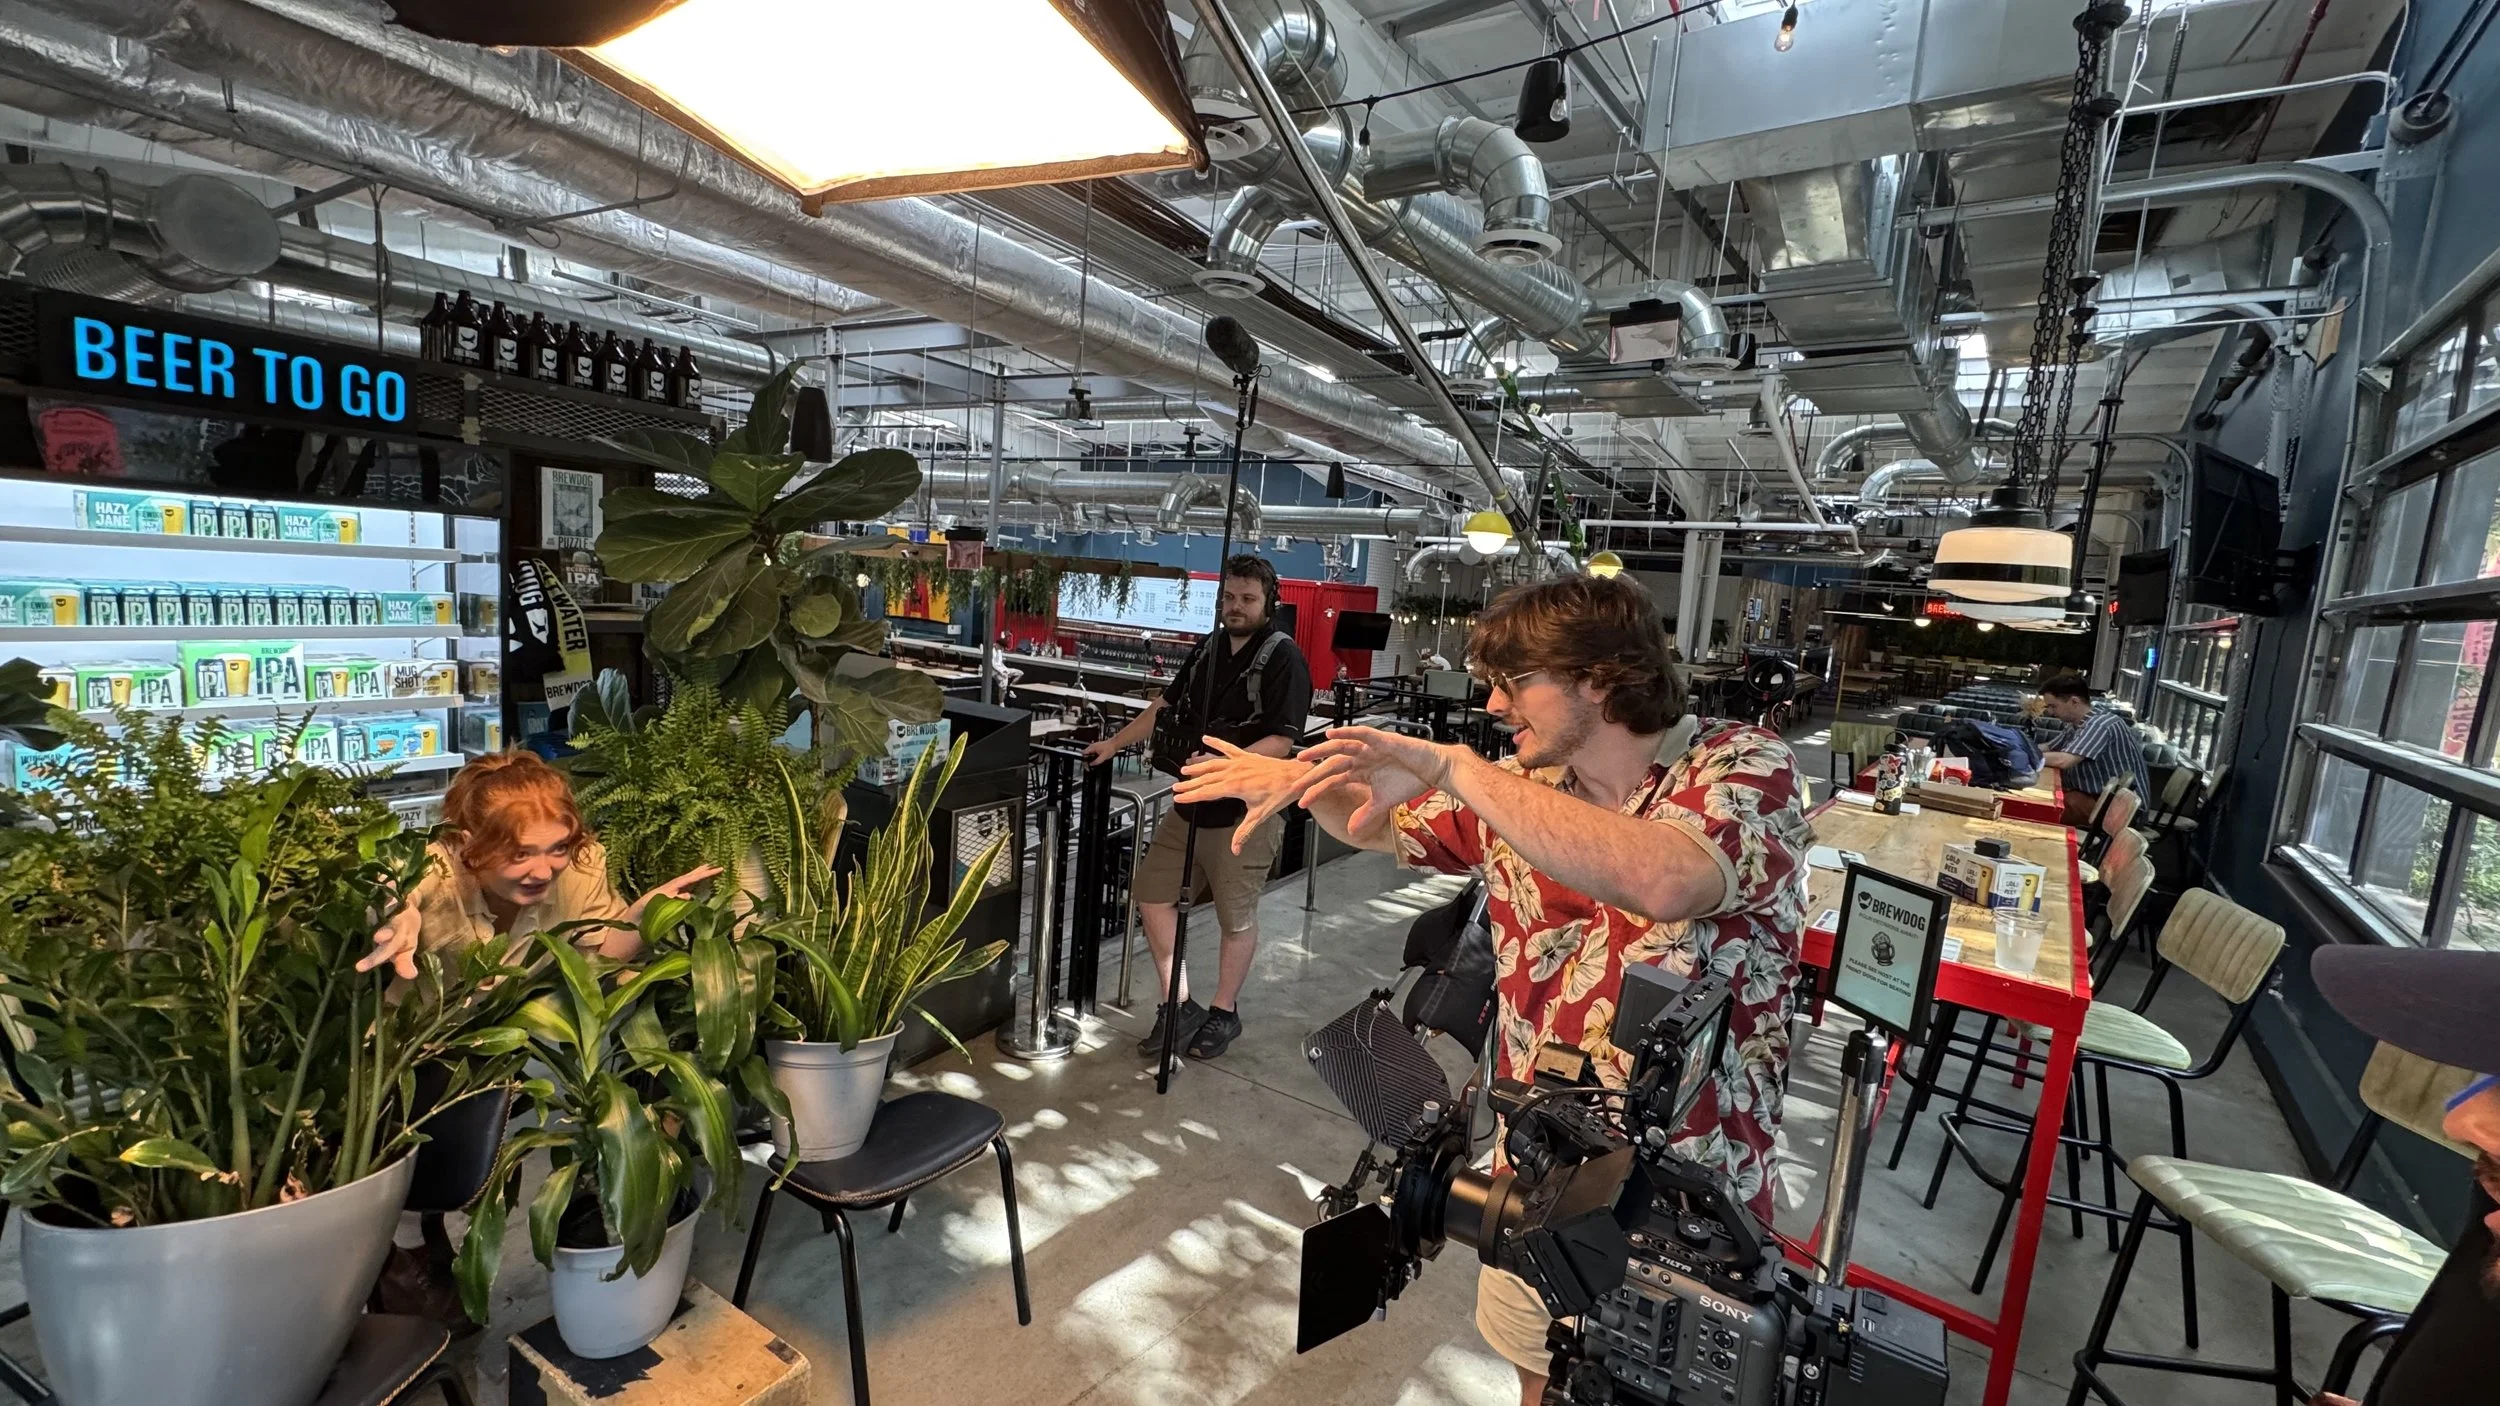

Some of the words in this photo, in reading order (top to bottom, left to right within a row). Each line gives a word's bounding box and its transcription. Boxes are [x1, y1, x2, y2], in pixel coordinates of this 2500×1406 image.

[73, 316, 236, 400] BEER
[252, 347, 323, 411] TO
[341, 363, 406, 422] GO
[552, 470, 593, 487] BREWDOG
[95, 501, 130, 515] HAZY
[95, 514, 132, 527] JANE
[194, 513, 219, 536] IPA
[222, 515, 248, 538] IPA
[252, 517, 277, 540] IPA
[284, 514, 313, 526] HAZY
[285, 526, 313, 537] JANE
[558, 536, 588, 550] PUZZLE
[567, 572, 599, 585] IPA
[91, 601, 120, 625] IPA
[124, 601, 153, 625] IPA
[157, 601, 184, 625] IPA
[189, 601, 215, 625] IPA
[220, 601, 245, 625] IPA
[248, 601, 273, 625] IPA
[277, 601, 300, 625] IPA
[302, 603, 326, 625] IPA
[329, 603, 352, 625] IPA
[356, 603, 378, 625] IPA
[387, 600, 412, 611] HAZY
[388, 611, 413, 621] JANE
[255, 657, 301, 694] IPA
[354, 671, 380, 694] IPA
[395, 665, 417, 678] MUG
[140, 678, 173, 704] IPA
[198, 671, 227, 698] IPA
[906, 723, 938, 736] BREWDOG
[304, 737, 332, 760] IPA
[343, 739, 364, 762] IPA
[1872, 899, 1926, 931] BREWDOG
[1659, 1255, 1692, 1273] TILTA
[1699, 1295, 1754, 1324] SONY
